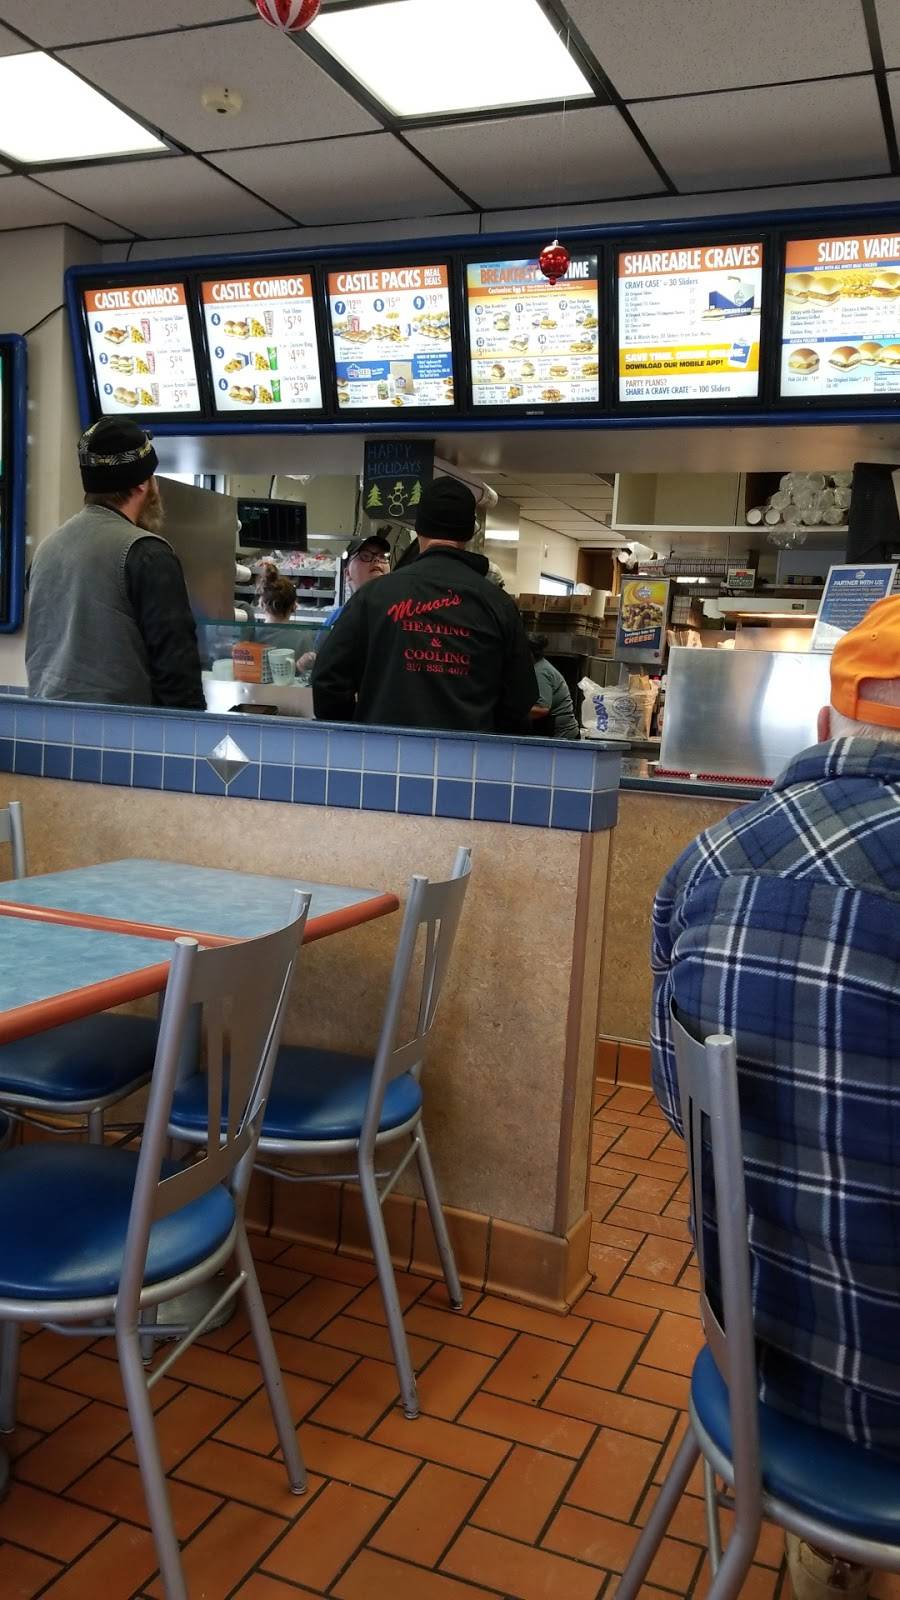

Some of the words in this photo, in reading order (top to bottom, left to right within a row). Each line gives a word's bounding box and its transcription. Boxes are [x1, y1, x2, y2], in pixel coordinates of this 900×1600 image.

[818, 240, 860, 263] SLIDER
[863, 237, 900, 259] VARIE
[624, 250, 702, 274] SHAREABLE
[704, 246, 760, 267] CRAVES
[337, 272, 379, 292] CASTLE
[382, 269, 422, 289] PACKS
[625, 281, 644, 290] CRAVE
[669, 279, 677, 287] 30
[678, 278, 699, 286] Sliders
[94, 291, 131, 309] CASTLE
[132, 287, 179, 306] COMBOS
[212, 282, 250, 301] CASTLE
[253, 278, 305, 298] COMBOS
[625, 361, 662, 370] DOWNLOAD
[664, 361, 678, 369] OUR
[680, 360, 705, 368] MOBILE
[706, 359, 724, 367] APP!
[625, 380, 644, 388] PARTY
[645, 379, 667, 387] PLANS?
[625, 387, 644, 396] SHARE
[645, 387, 650, 395] A
[651, 387, 670, 395] CRAVE
[699, 385, 709, 393] 100
[710, 384, 731, 392] Sliders
[368, 442, 413, 459] HAPPY
[368, 460, 422, 476] HOLIDAYS
[387, 588, 462, 623] Minor's
[402, 619, 471, 638] HEATING
[430, 636, 442, 648] &
[624, 633, 656, 644] CHEESE!
[404, 648, 471, 666] COOLING
